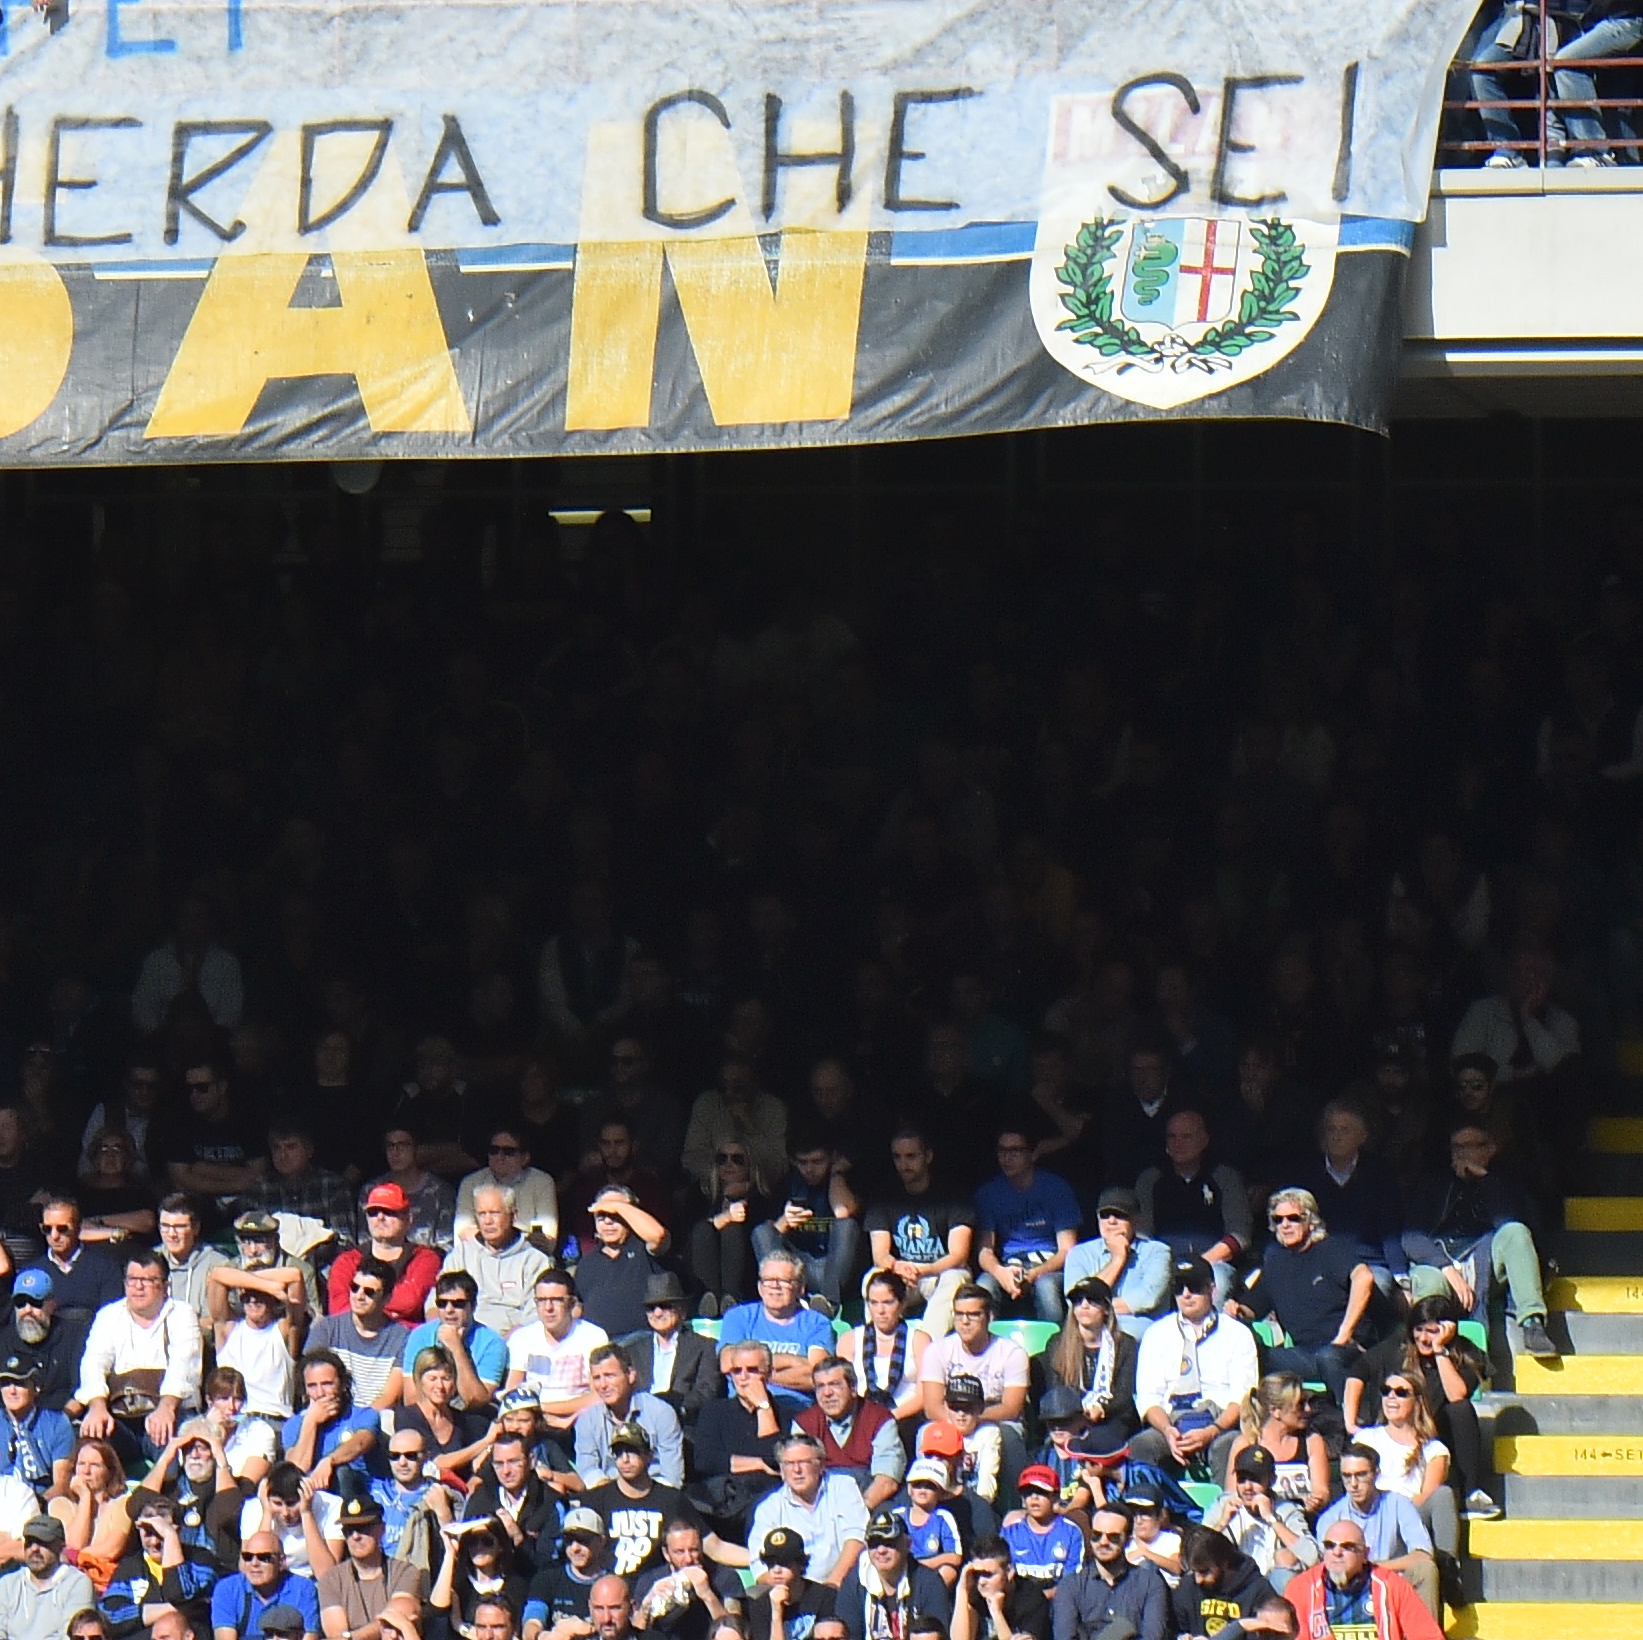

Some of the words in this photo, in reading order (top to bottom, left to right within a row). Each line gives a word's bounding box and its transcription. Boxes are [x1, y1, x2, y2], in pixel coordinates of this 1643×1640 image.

[641, 84, 986, 228] CHE
[1574, 1448, 1598, 1461] 144
[608, 1510, 663, 1538] JUST
